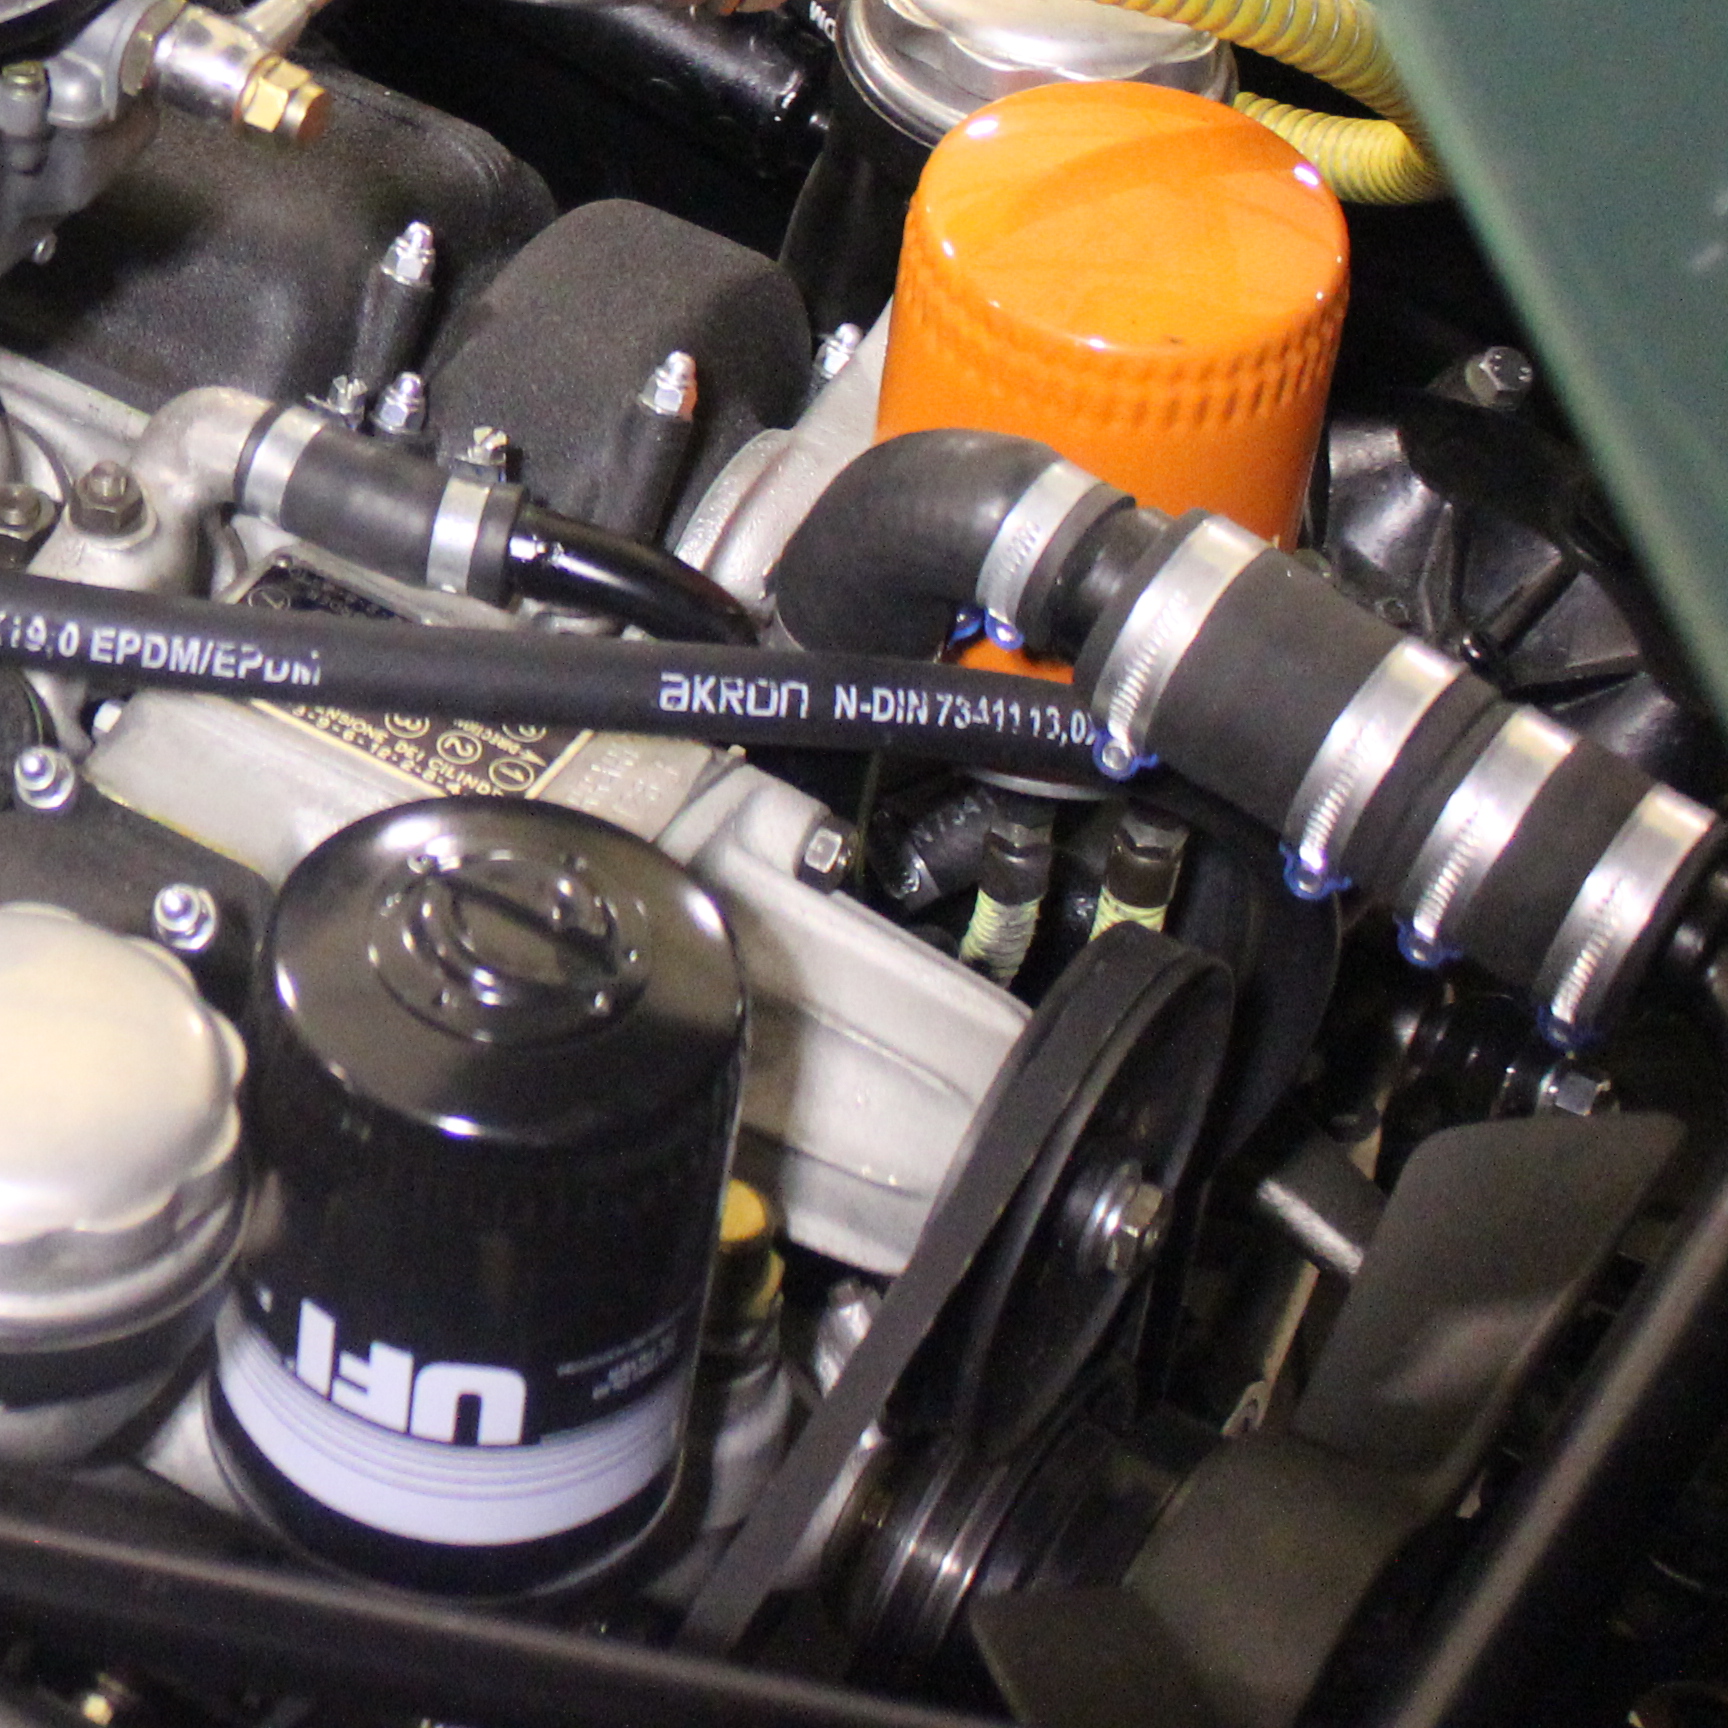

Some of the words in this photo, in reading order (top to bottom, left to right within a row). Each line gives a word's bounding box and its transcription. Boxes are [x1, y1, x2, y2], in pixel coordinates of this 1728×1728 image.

[90, 626, 322, 687] EPDM/EPDM
[834, 684, 928, 725] N-DIN
[296, 1298, 527, 1445] UFI
